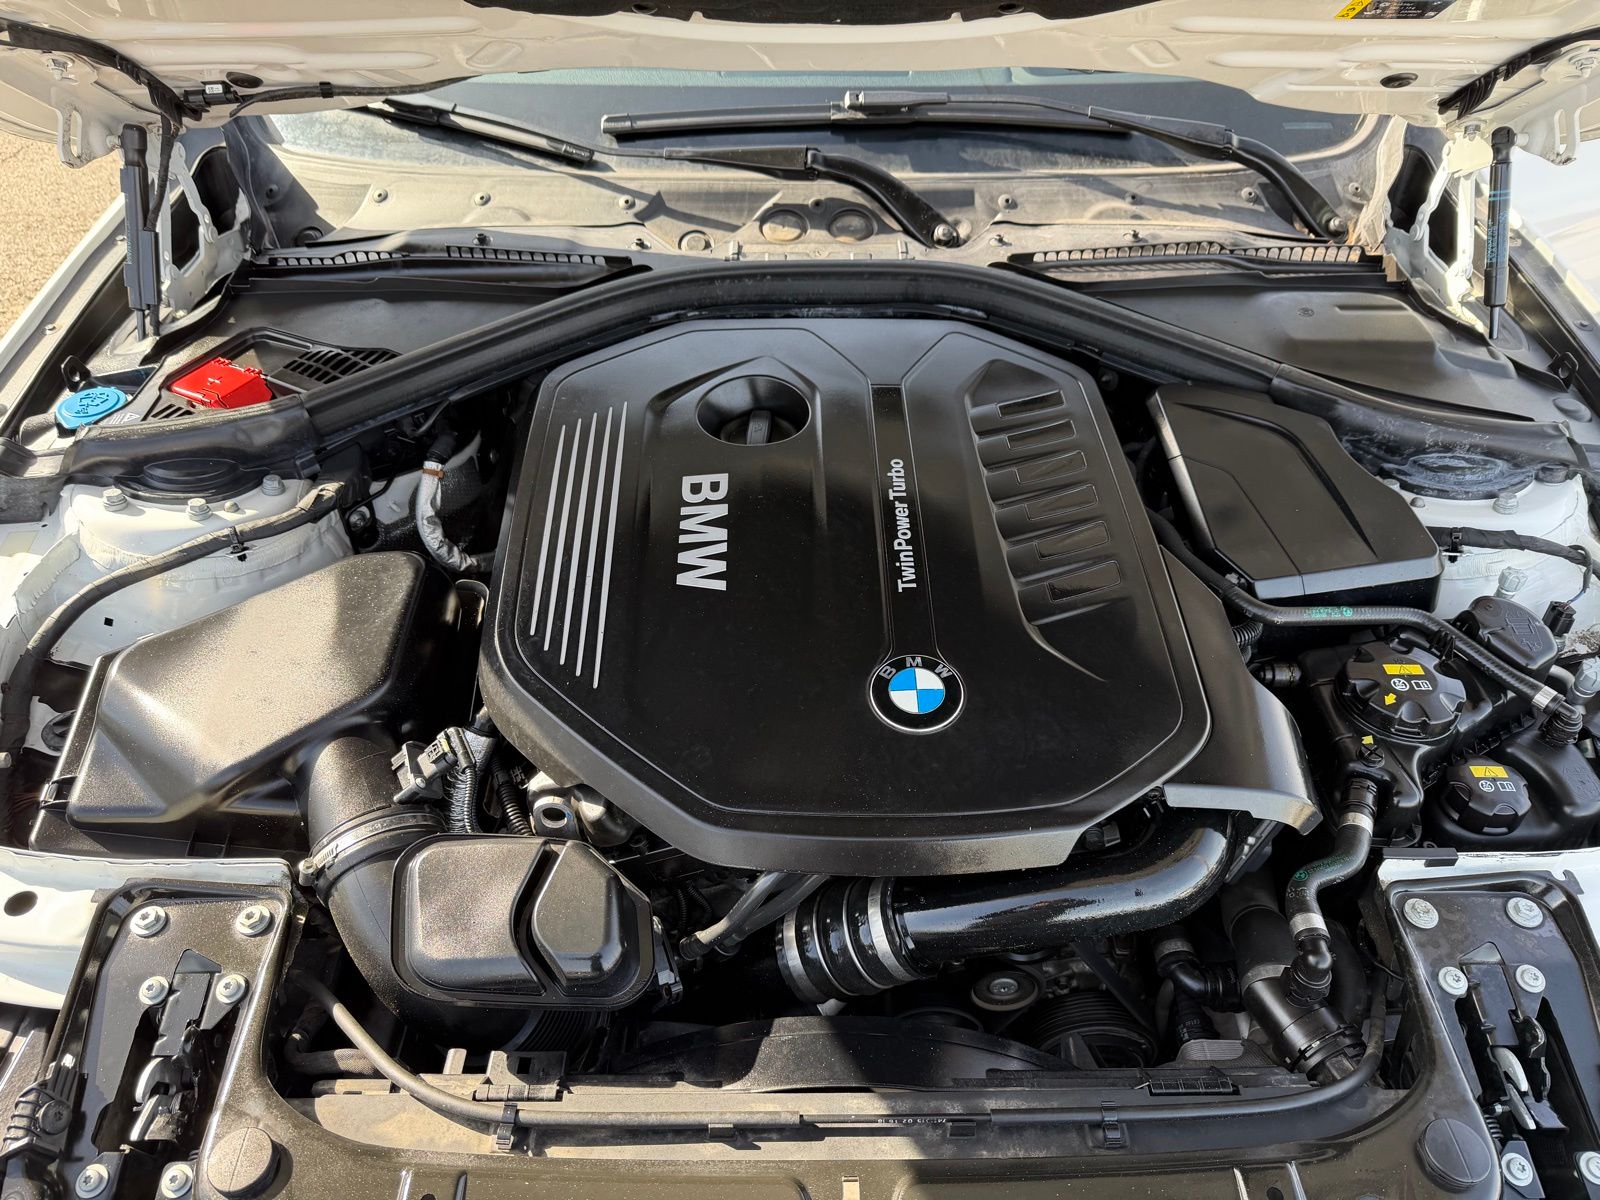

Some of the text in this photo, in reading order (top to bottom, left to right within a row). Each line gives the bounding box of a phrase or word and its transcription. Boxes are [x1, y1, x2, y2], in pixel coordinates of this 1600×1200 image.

[676, 473, 729, 591] BMW
[887, 458, 917, 593] TwinPower Turbo
[879, 656, 953, 680] BMW
